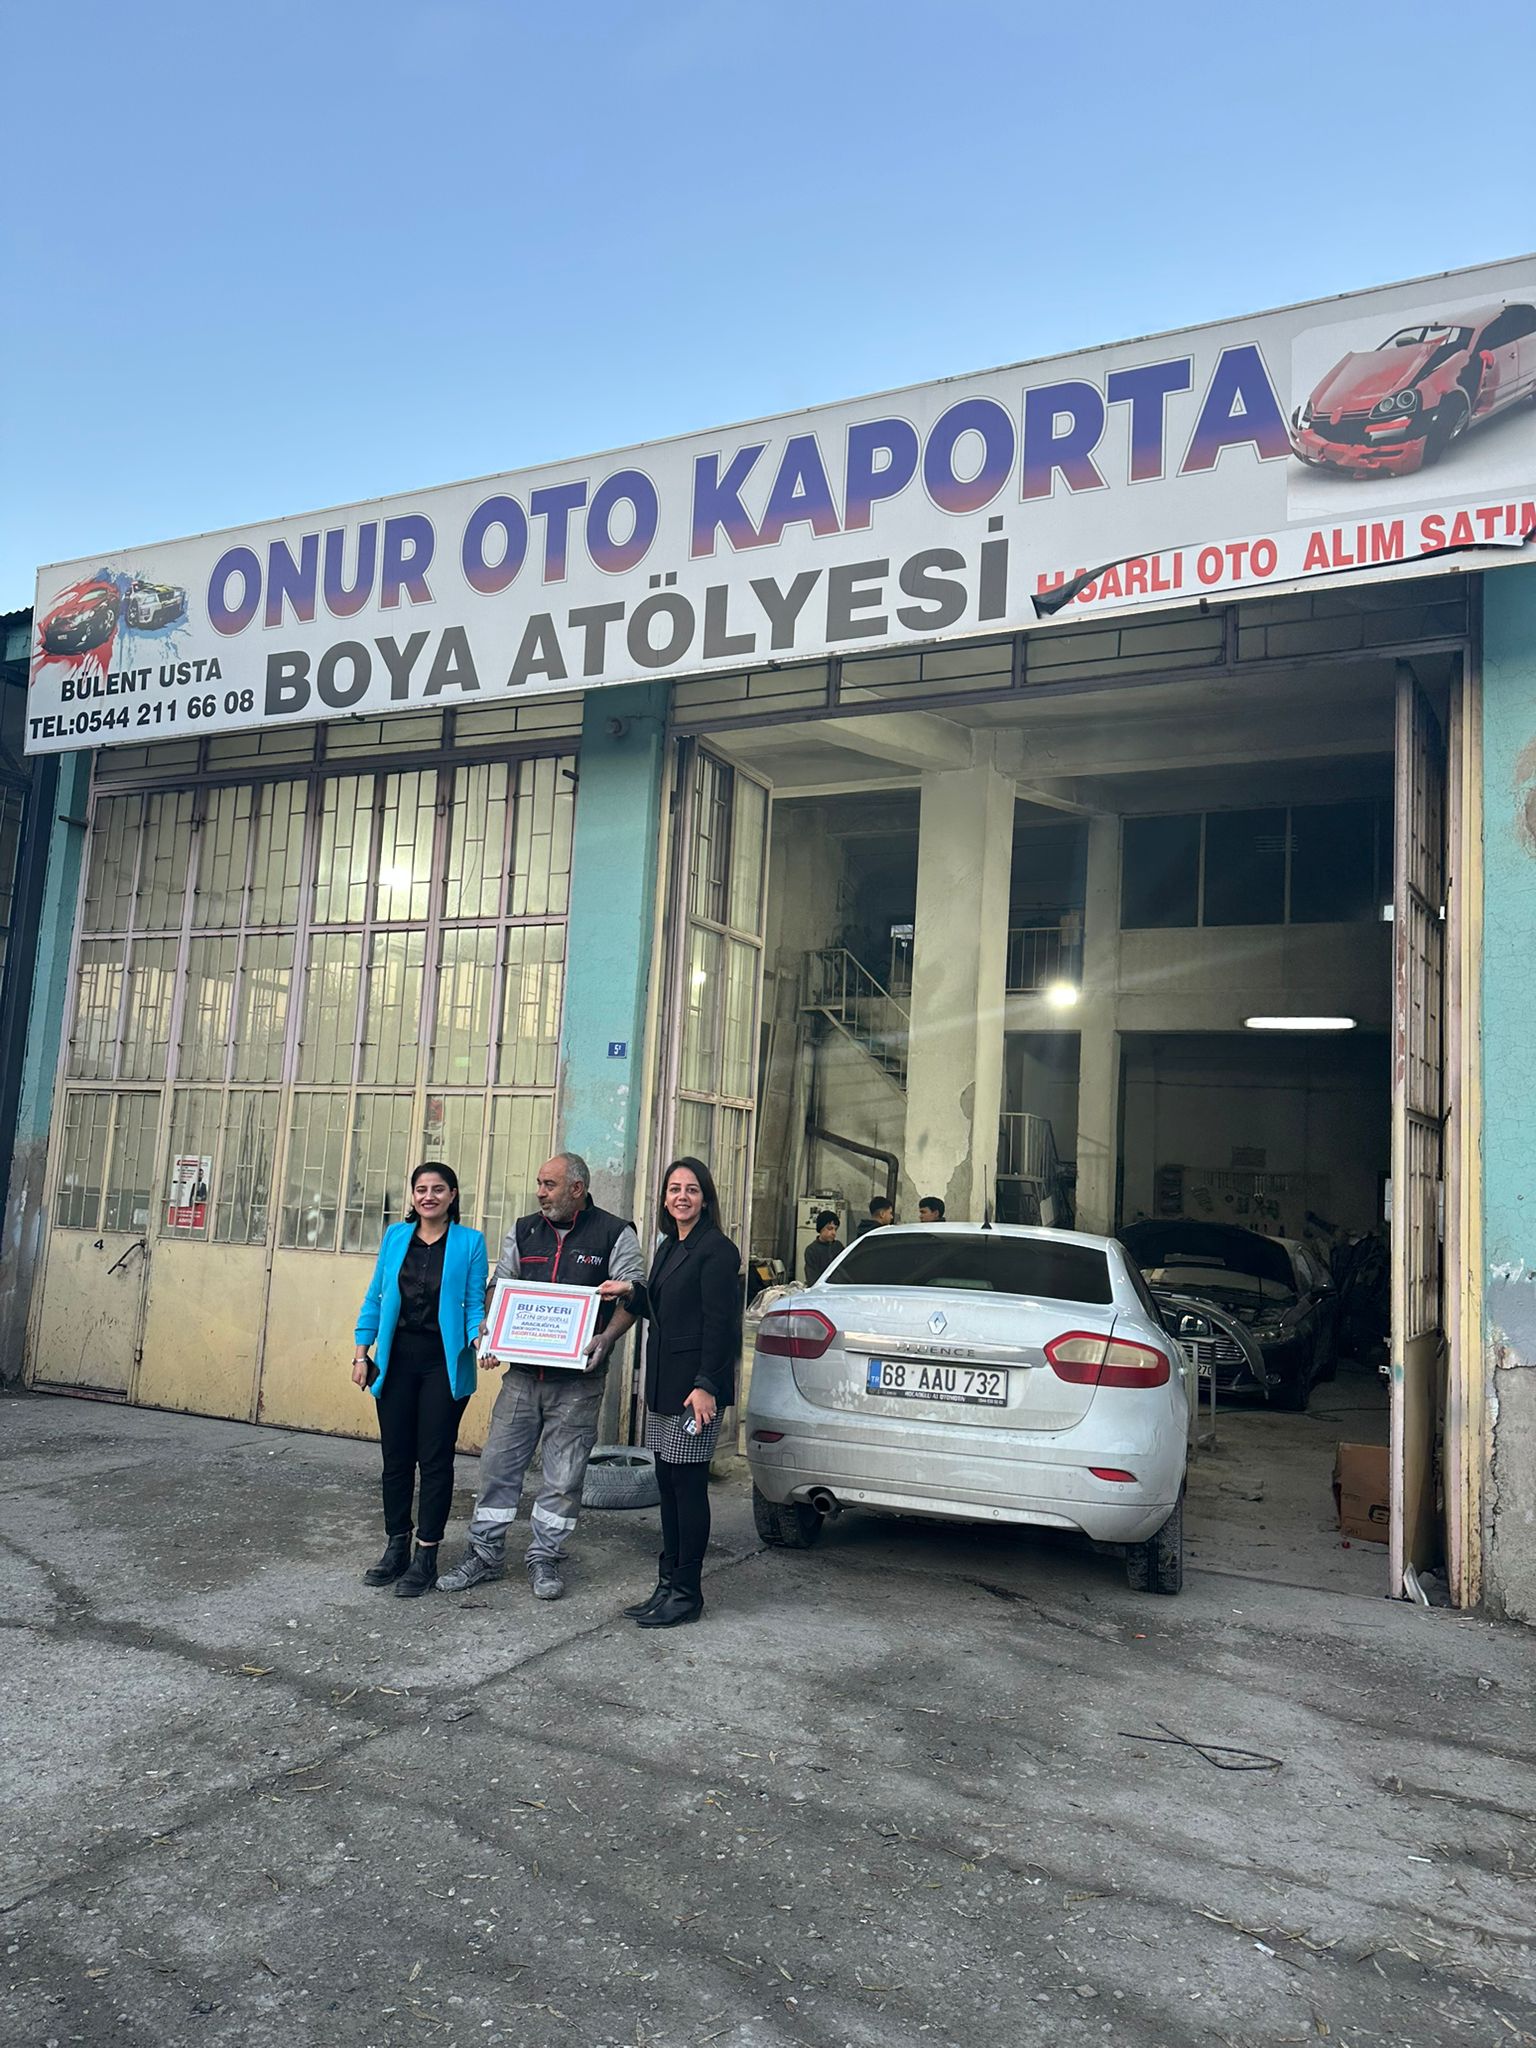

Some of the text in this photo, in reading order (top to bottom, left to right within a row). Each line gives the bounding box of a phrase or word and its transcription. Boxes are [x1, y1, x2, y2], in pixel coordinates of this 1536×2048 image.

[205, 341, 1292, 638] ONUR OTO KAPORTA
[1196, 538, 1278, 585] OTO
[1302, 520, 1404, 571] ALIM
[264, 516, 1009, 716] BOYA ATÖLYESİ
[61, 657, 222, 702] BÜLENT USTA
[30, 689, 254, 739] TEL:0544 211 66 08
[517, 1303, 533, 1312] BU
[882, 1364, 1000, 1396] 68 AAU 732
